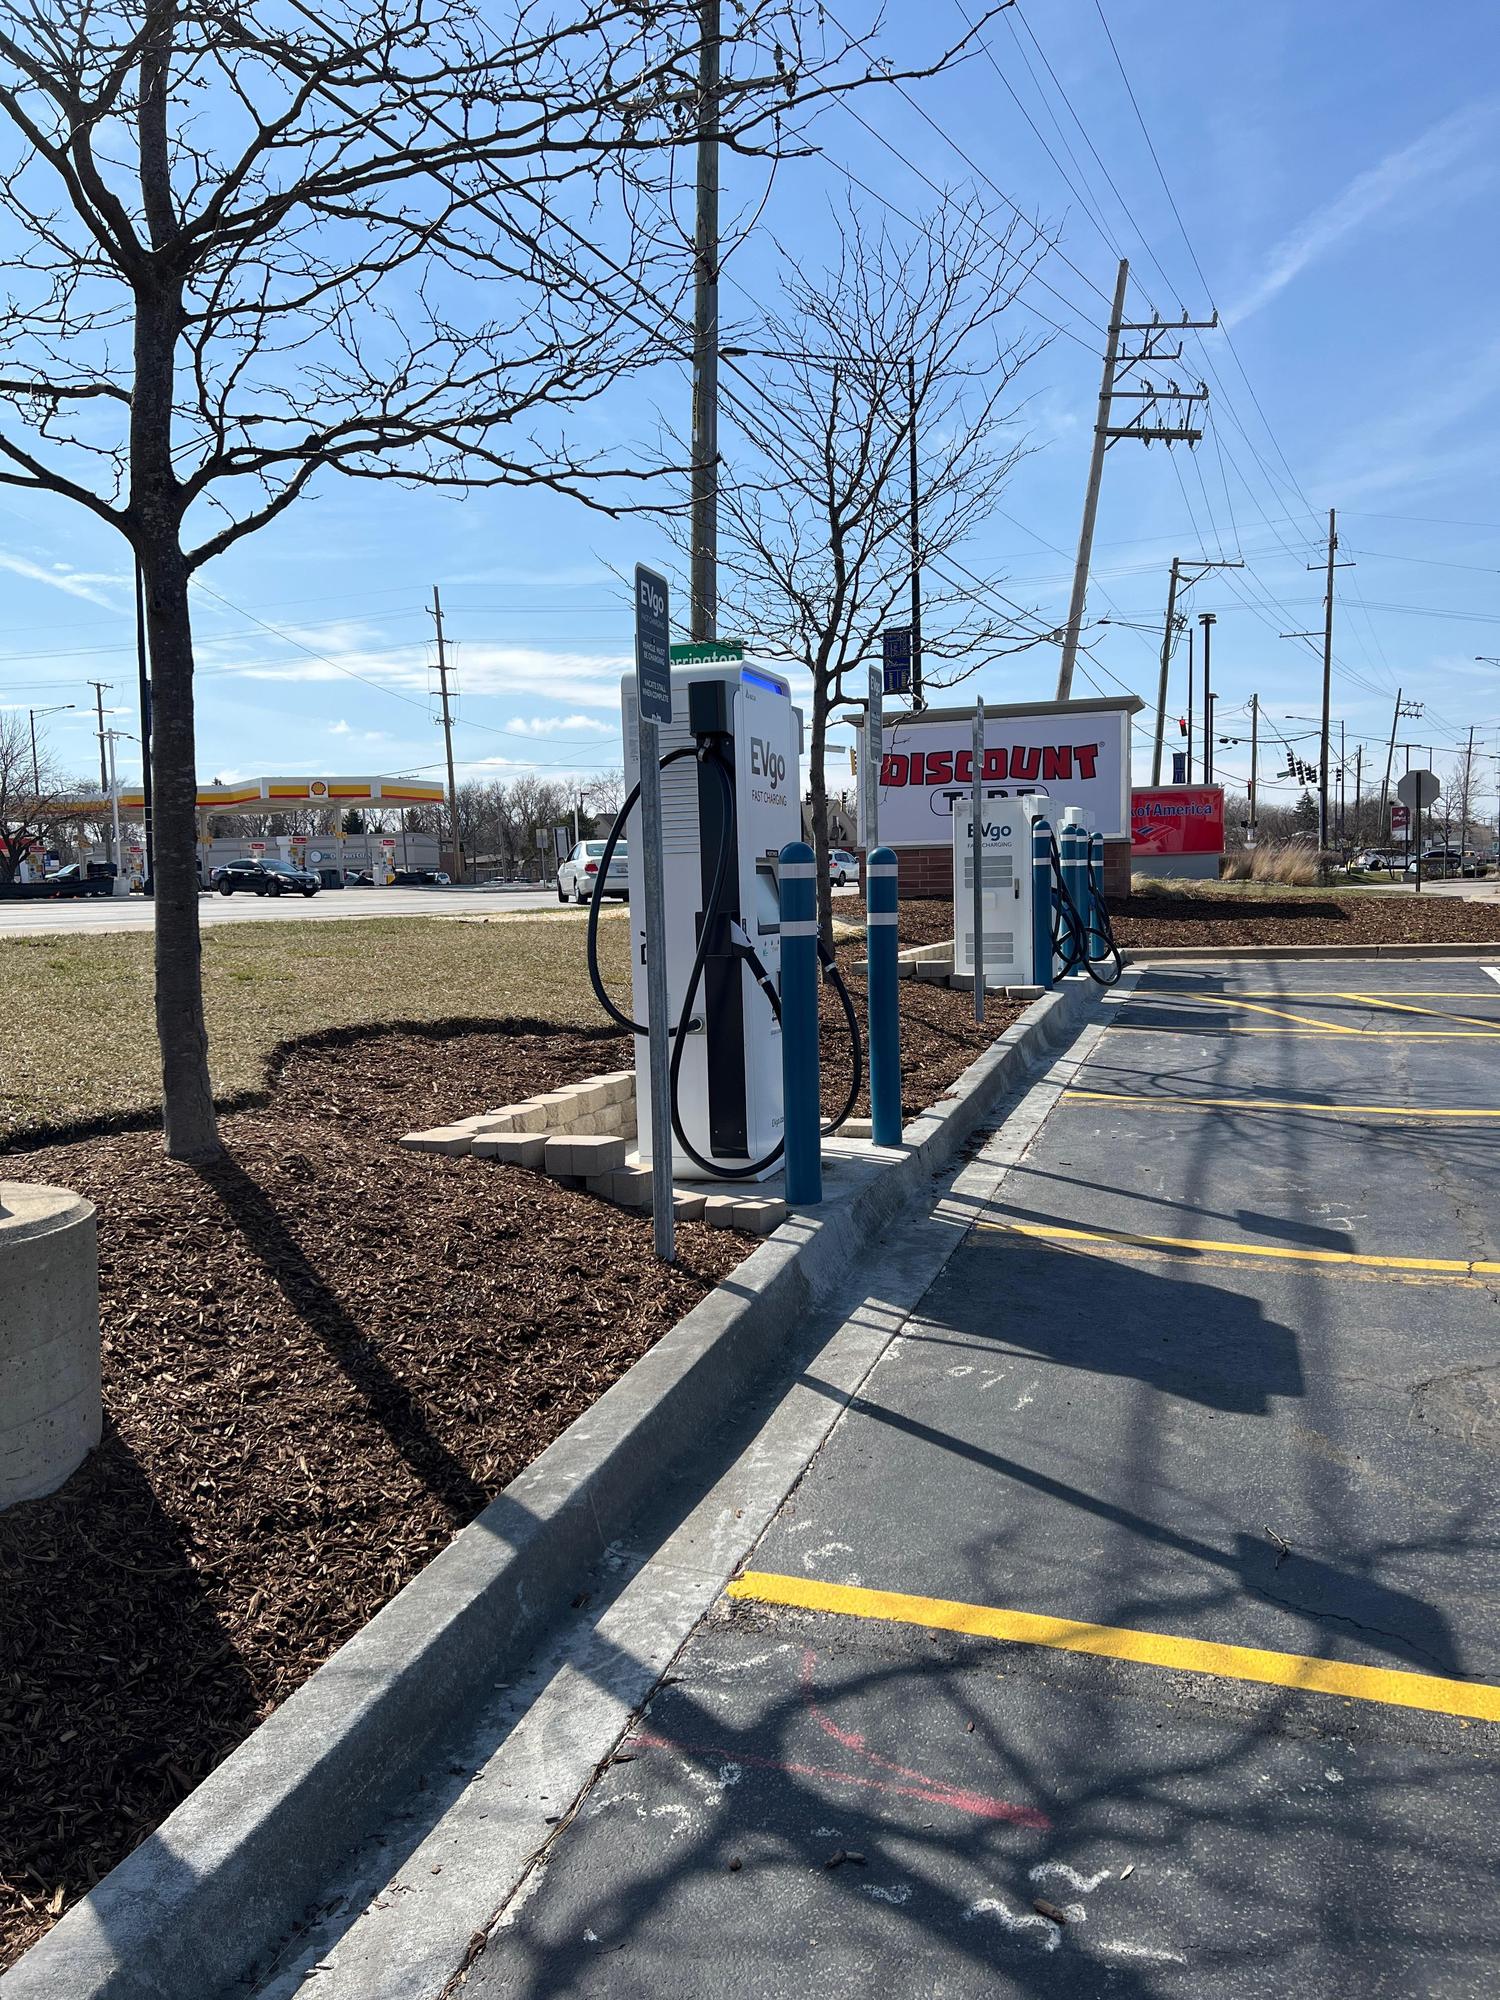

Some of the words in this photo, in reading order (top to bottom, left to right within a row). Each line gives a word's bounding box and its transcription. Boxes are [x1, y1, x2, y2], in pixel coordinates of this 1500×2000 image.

[640, 580, 664, 618] EVgo
[750, 736, 786, 790] EVgo
[879, 743, 1099, 787] DISCOUNT
[752, 789, 763, 803] FAST
[763, 792, 787, 806] CHARGING
[1137, 803, 1151, 817] of
[1153, 802, 1212, 817] America
[967, 822, 1012, 841] EVgo
